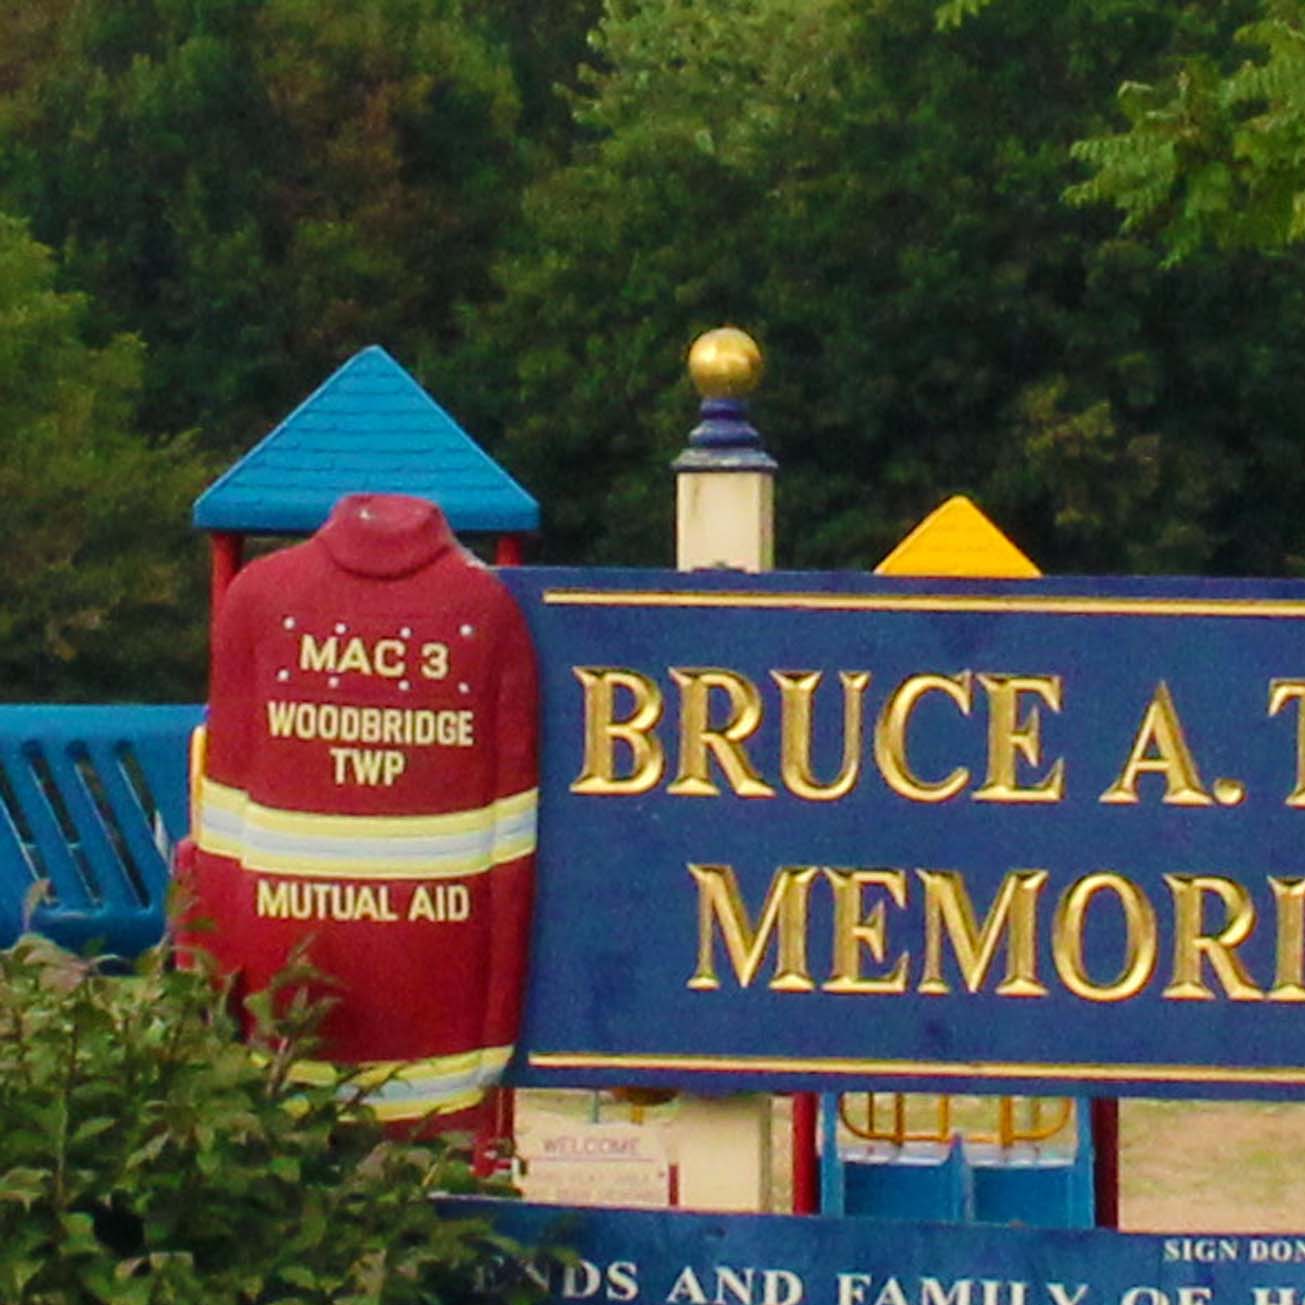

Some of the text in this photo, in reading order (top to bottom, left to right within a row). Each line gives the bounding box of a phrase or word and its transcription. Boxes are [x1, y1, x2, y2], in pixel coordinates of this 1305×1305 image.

[299, 634, 450, 679] MAC 3
[266, 699, 475, 749] WOODBRIDGE
[569, 665, 1064, 802] BRUCE
[1098, 680, 1244, 806] A.
[328, 746, 406, 787] TWP
[256, 878, 470, 923] MUTUAL AID
[543, 1135, 641, 1156] WELCOME
[1163, 1238, 1240, 1263] SIGN
